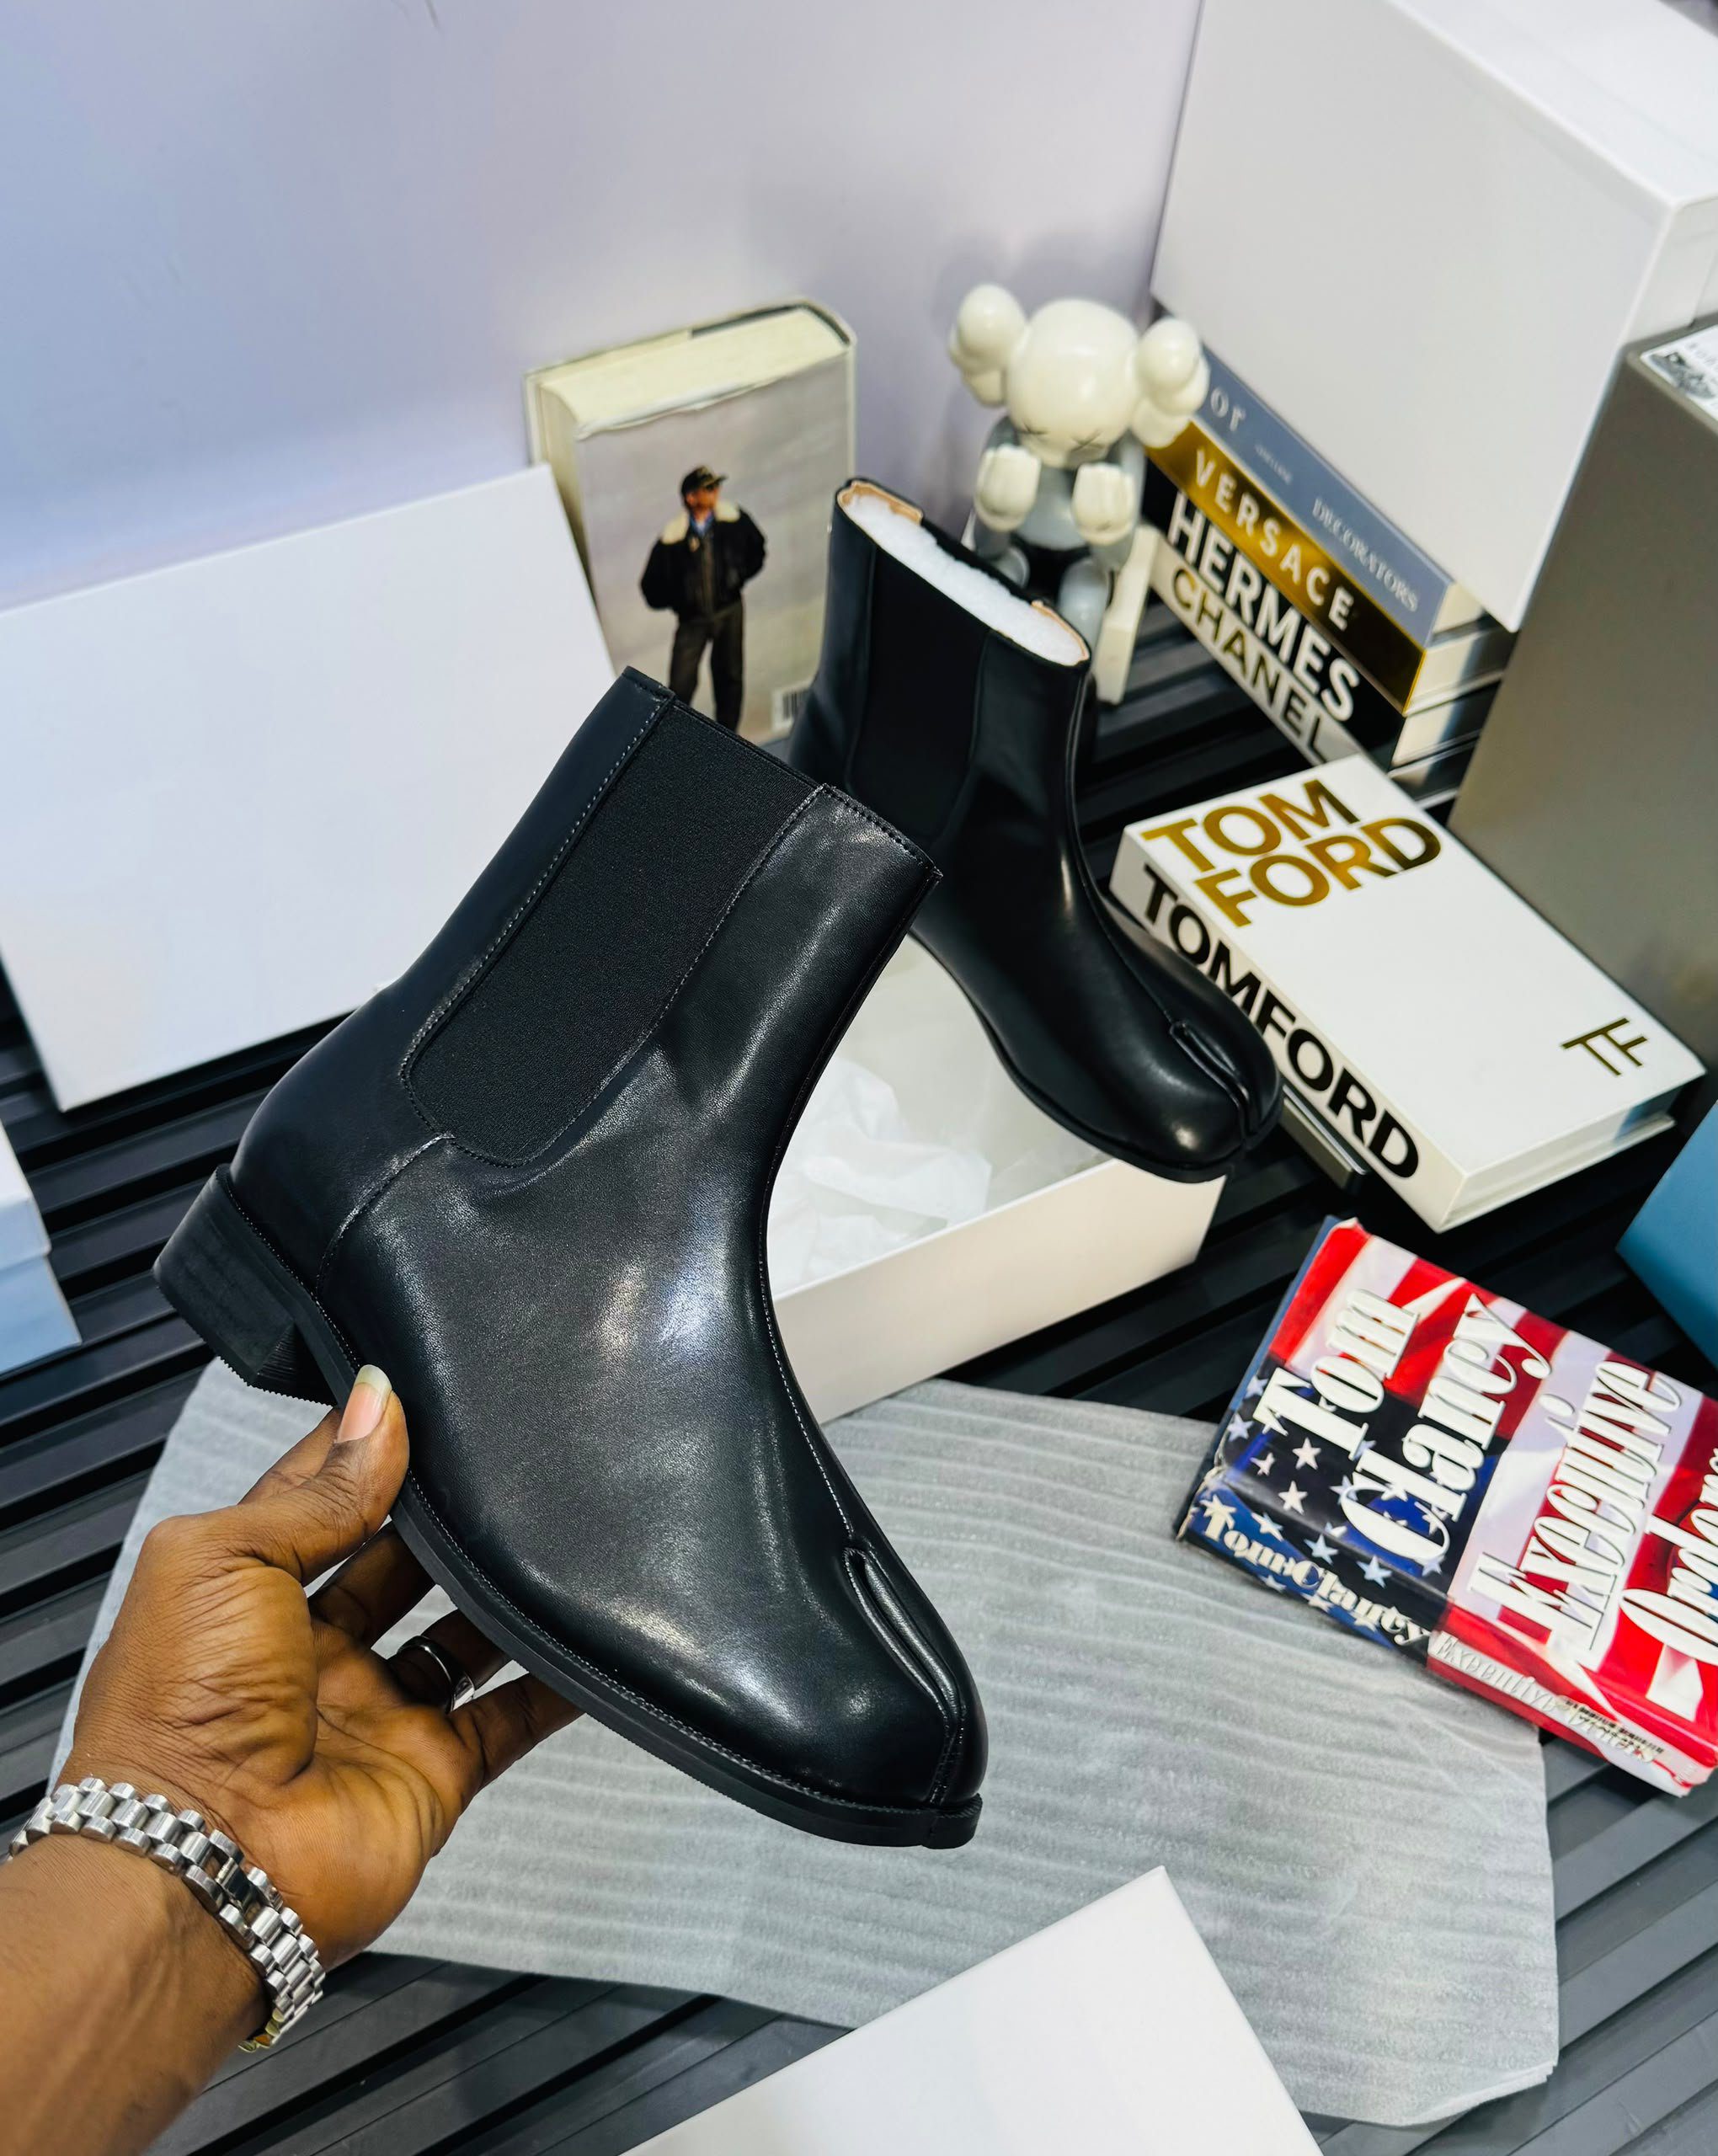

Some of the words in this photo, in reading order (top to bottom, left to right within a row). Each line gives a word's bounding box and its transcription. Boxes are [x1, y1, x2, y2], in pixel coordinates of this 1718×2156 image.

[1166, 490, 1360, 723] HERMES
[1194, 447, 1355, 632] VERSACE
[1172, 567, 1326, 763] CHANEL
[1142, 780, 1361, 873] TOM
[1193, 817, 1442, 928] FORD
[1144, 863, 1419, 1179] TOMFORD
[1252, 1289, 1421, 1460] Tom
[1341, 1294, 1554, 1561] Clancy
[1465, 1359, 1683, 1652] Executive
